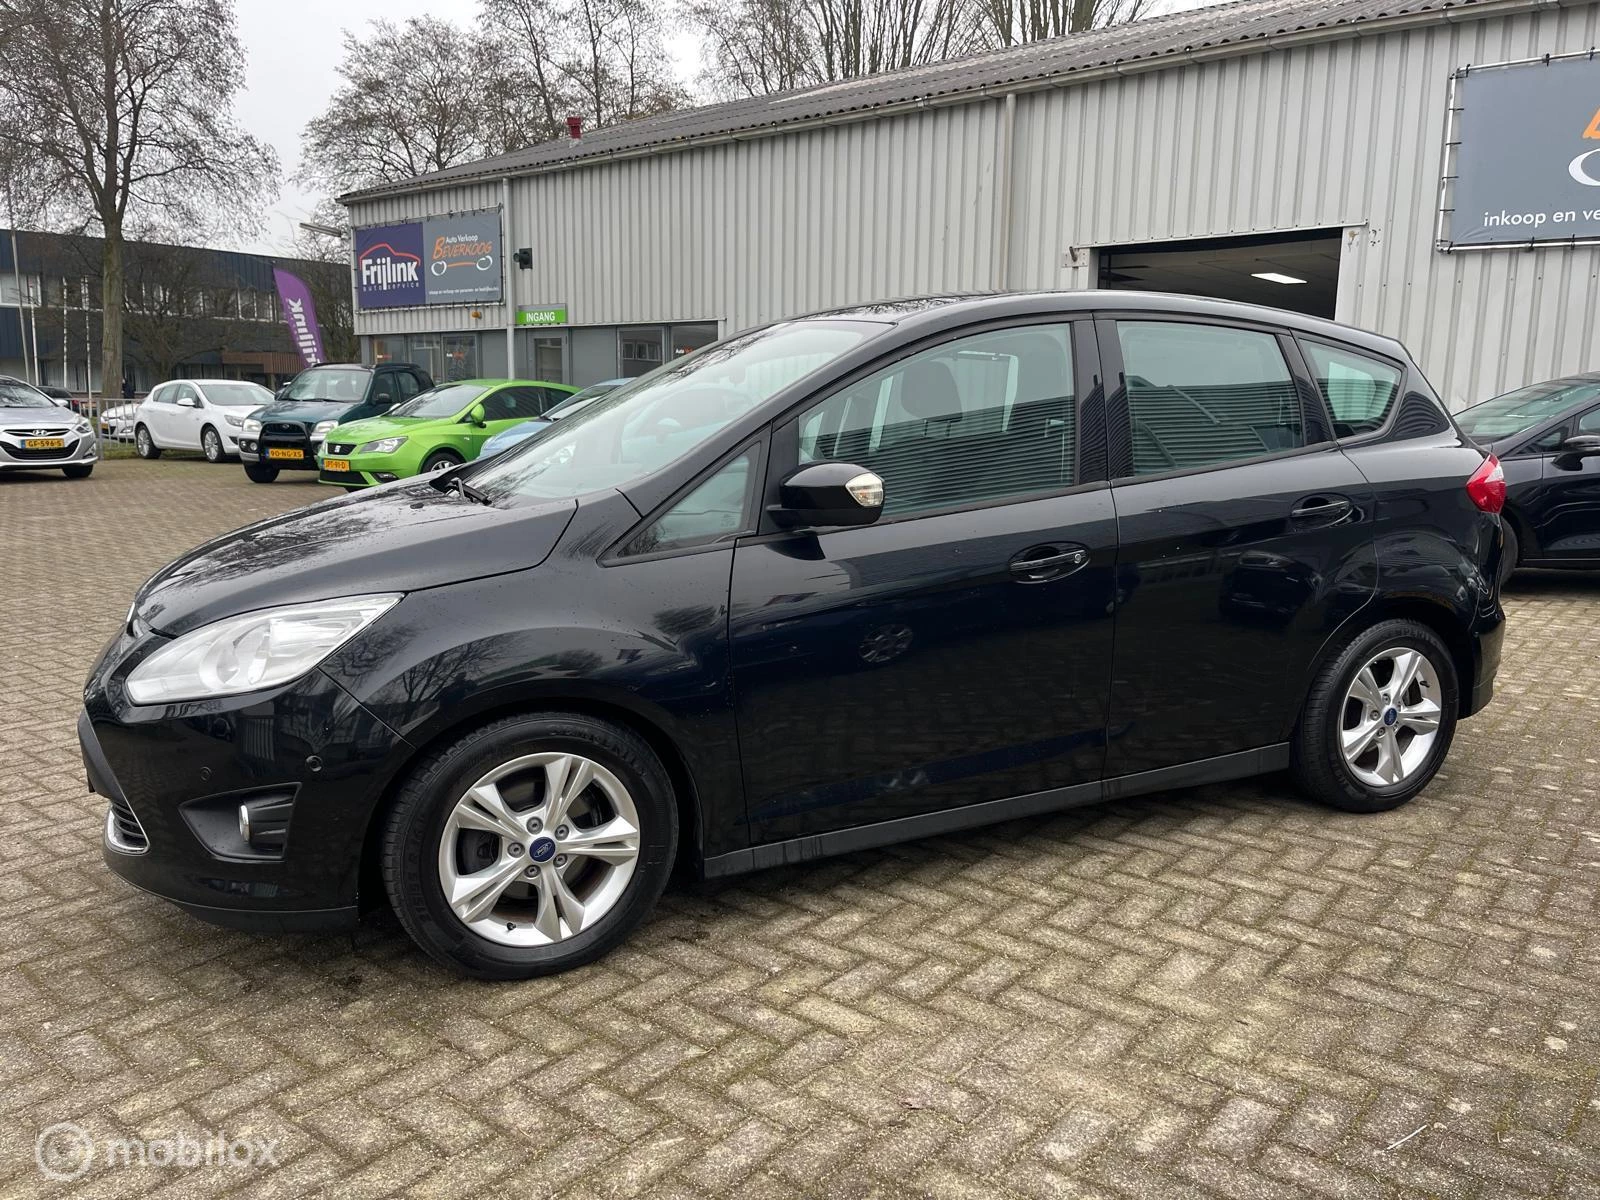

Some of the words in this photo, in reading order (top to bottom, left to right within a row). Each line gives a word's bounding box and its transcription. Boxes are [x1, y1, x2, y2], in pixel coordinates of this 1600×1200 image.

[1484, 210, 1546, 228] inkoop
[1553, 211, 1576, 222] en
[446, 236, 457, 244] Auto
[458, 234, 479, 243] Verkoop
[526, 311, 555, 323] INGANG
